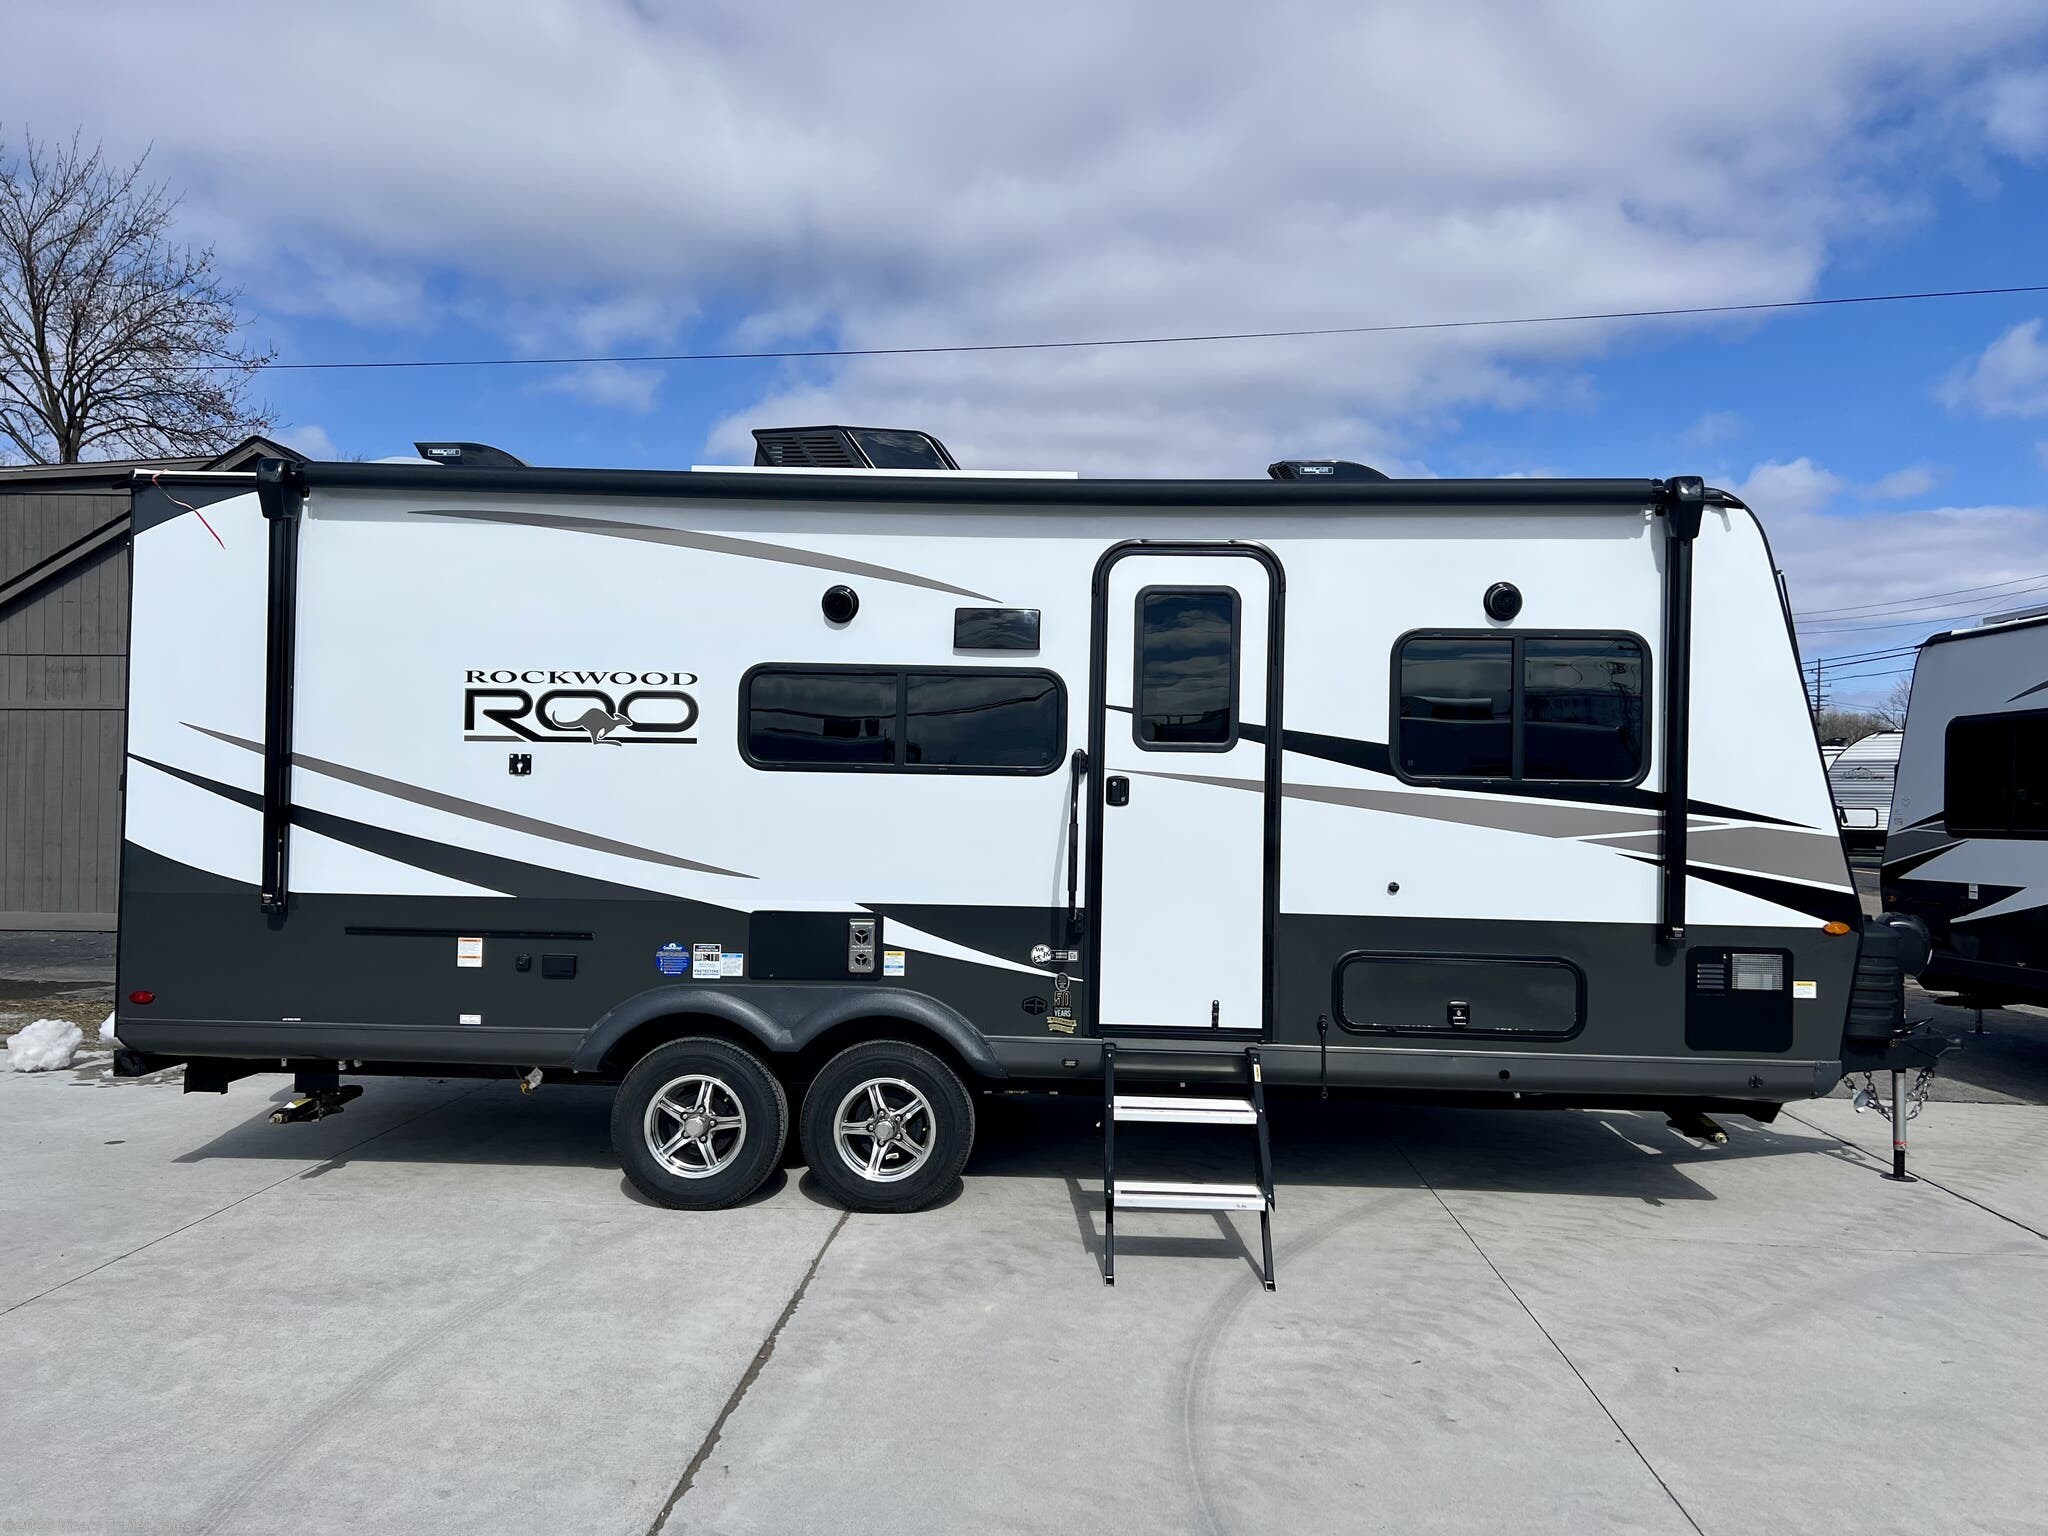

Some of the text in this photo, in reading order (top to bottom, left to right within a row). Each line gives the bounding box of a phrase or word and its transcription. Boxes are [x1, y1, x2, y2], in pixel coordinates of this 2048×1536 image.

[464, 670, 698, 686] ROCKWOOD
[464, 688, 699, 743] ROO
[1054, 1009, 1072, 1018] YEARS
